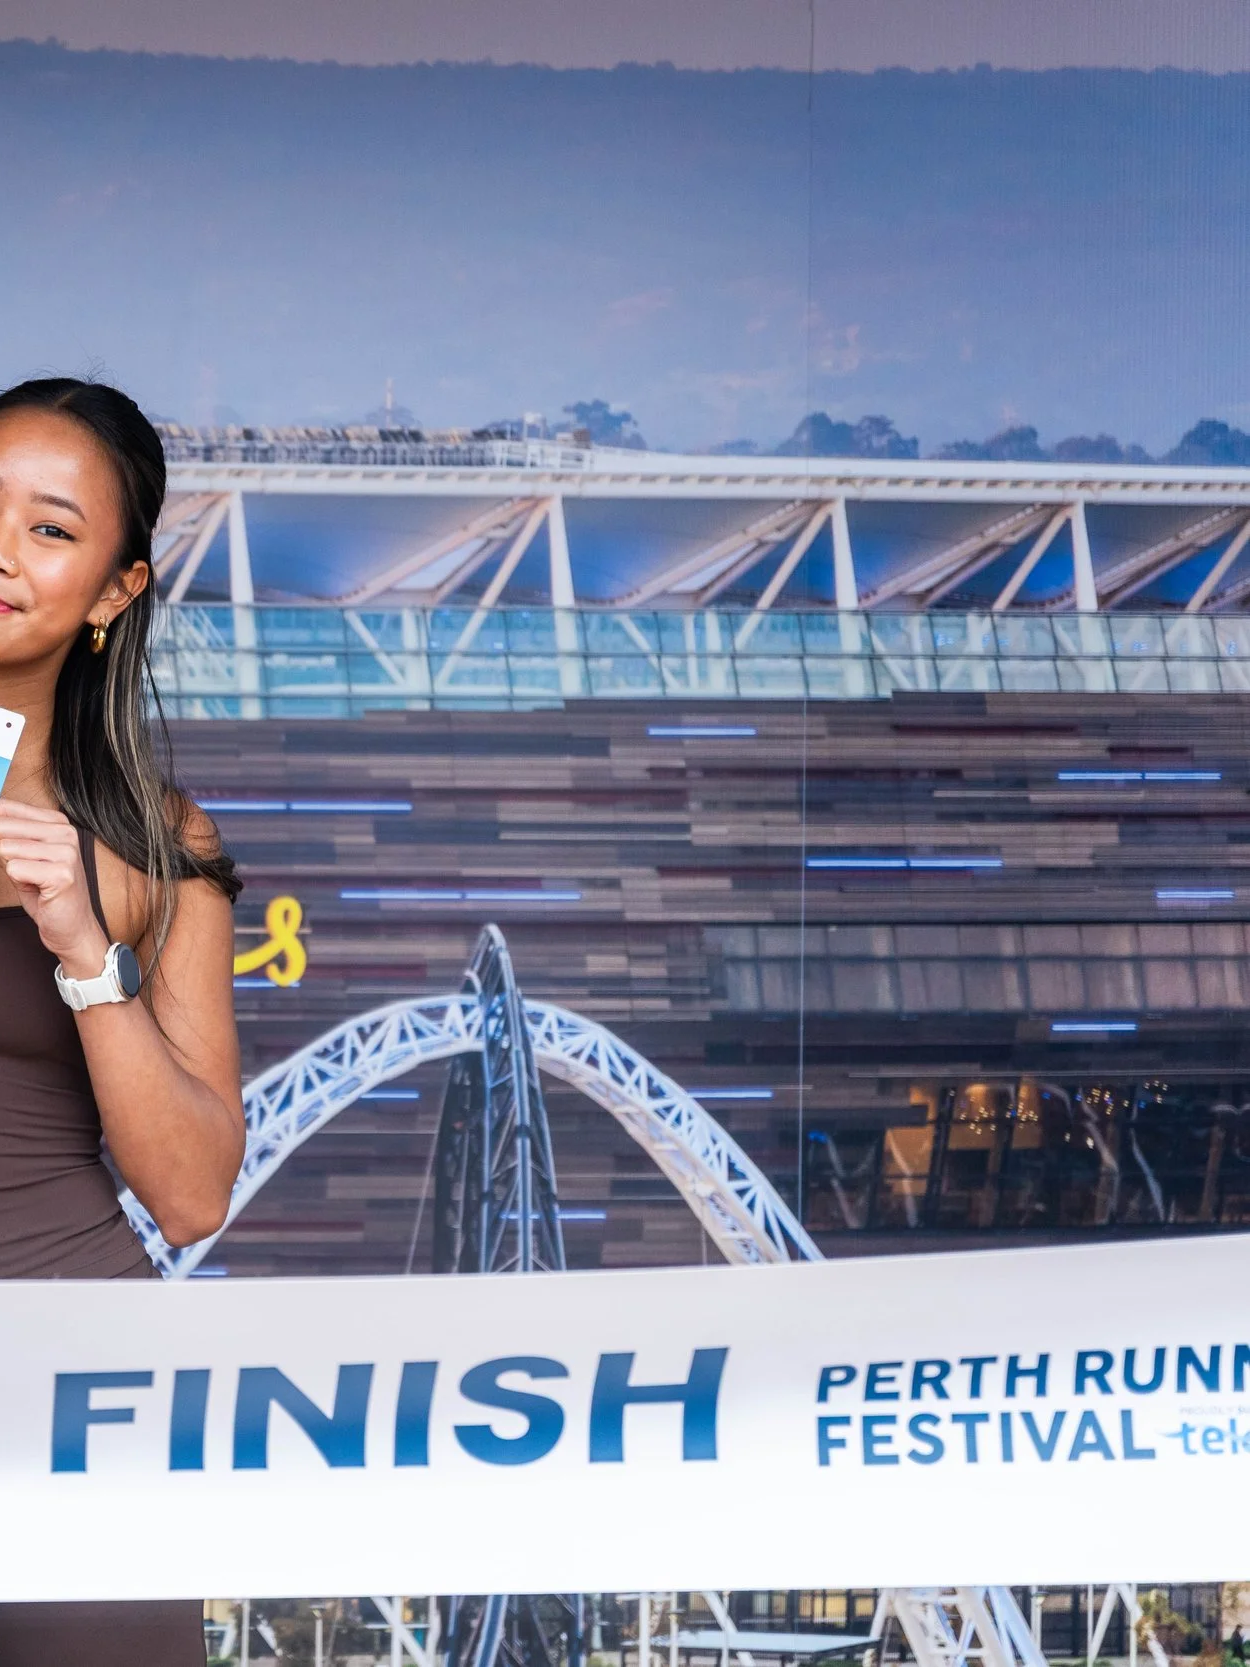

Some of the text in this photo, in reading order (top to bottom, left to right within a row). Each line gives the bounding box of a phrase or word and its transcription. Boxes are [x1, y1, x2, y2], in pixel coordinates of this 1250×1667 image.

[817, 1353, 1050, 1404] PERTH
[51, 1347, 729, 1473] FINISH
[817, 1409, 1156, 1466] FESTIVAL
